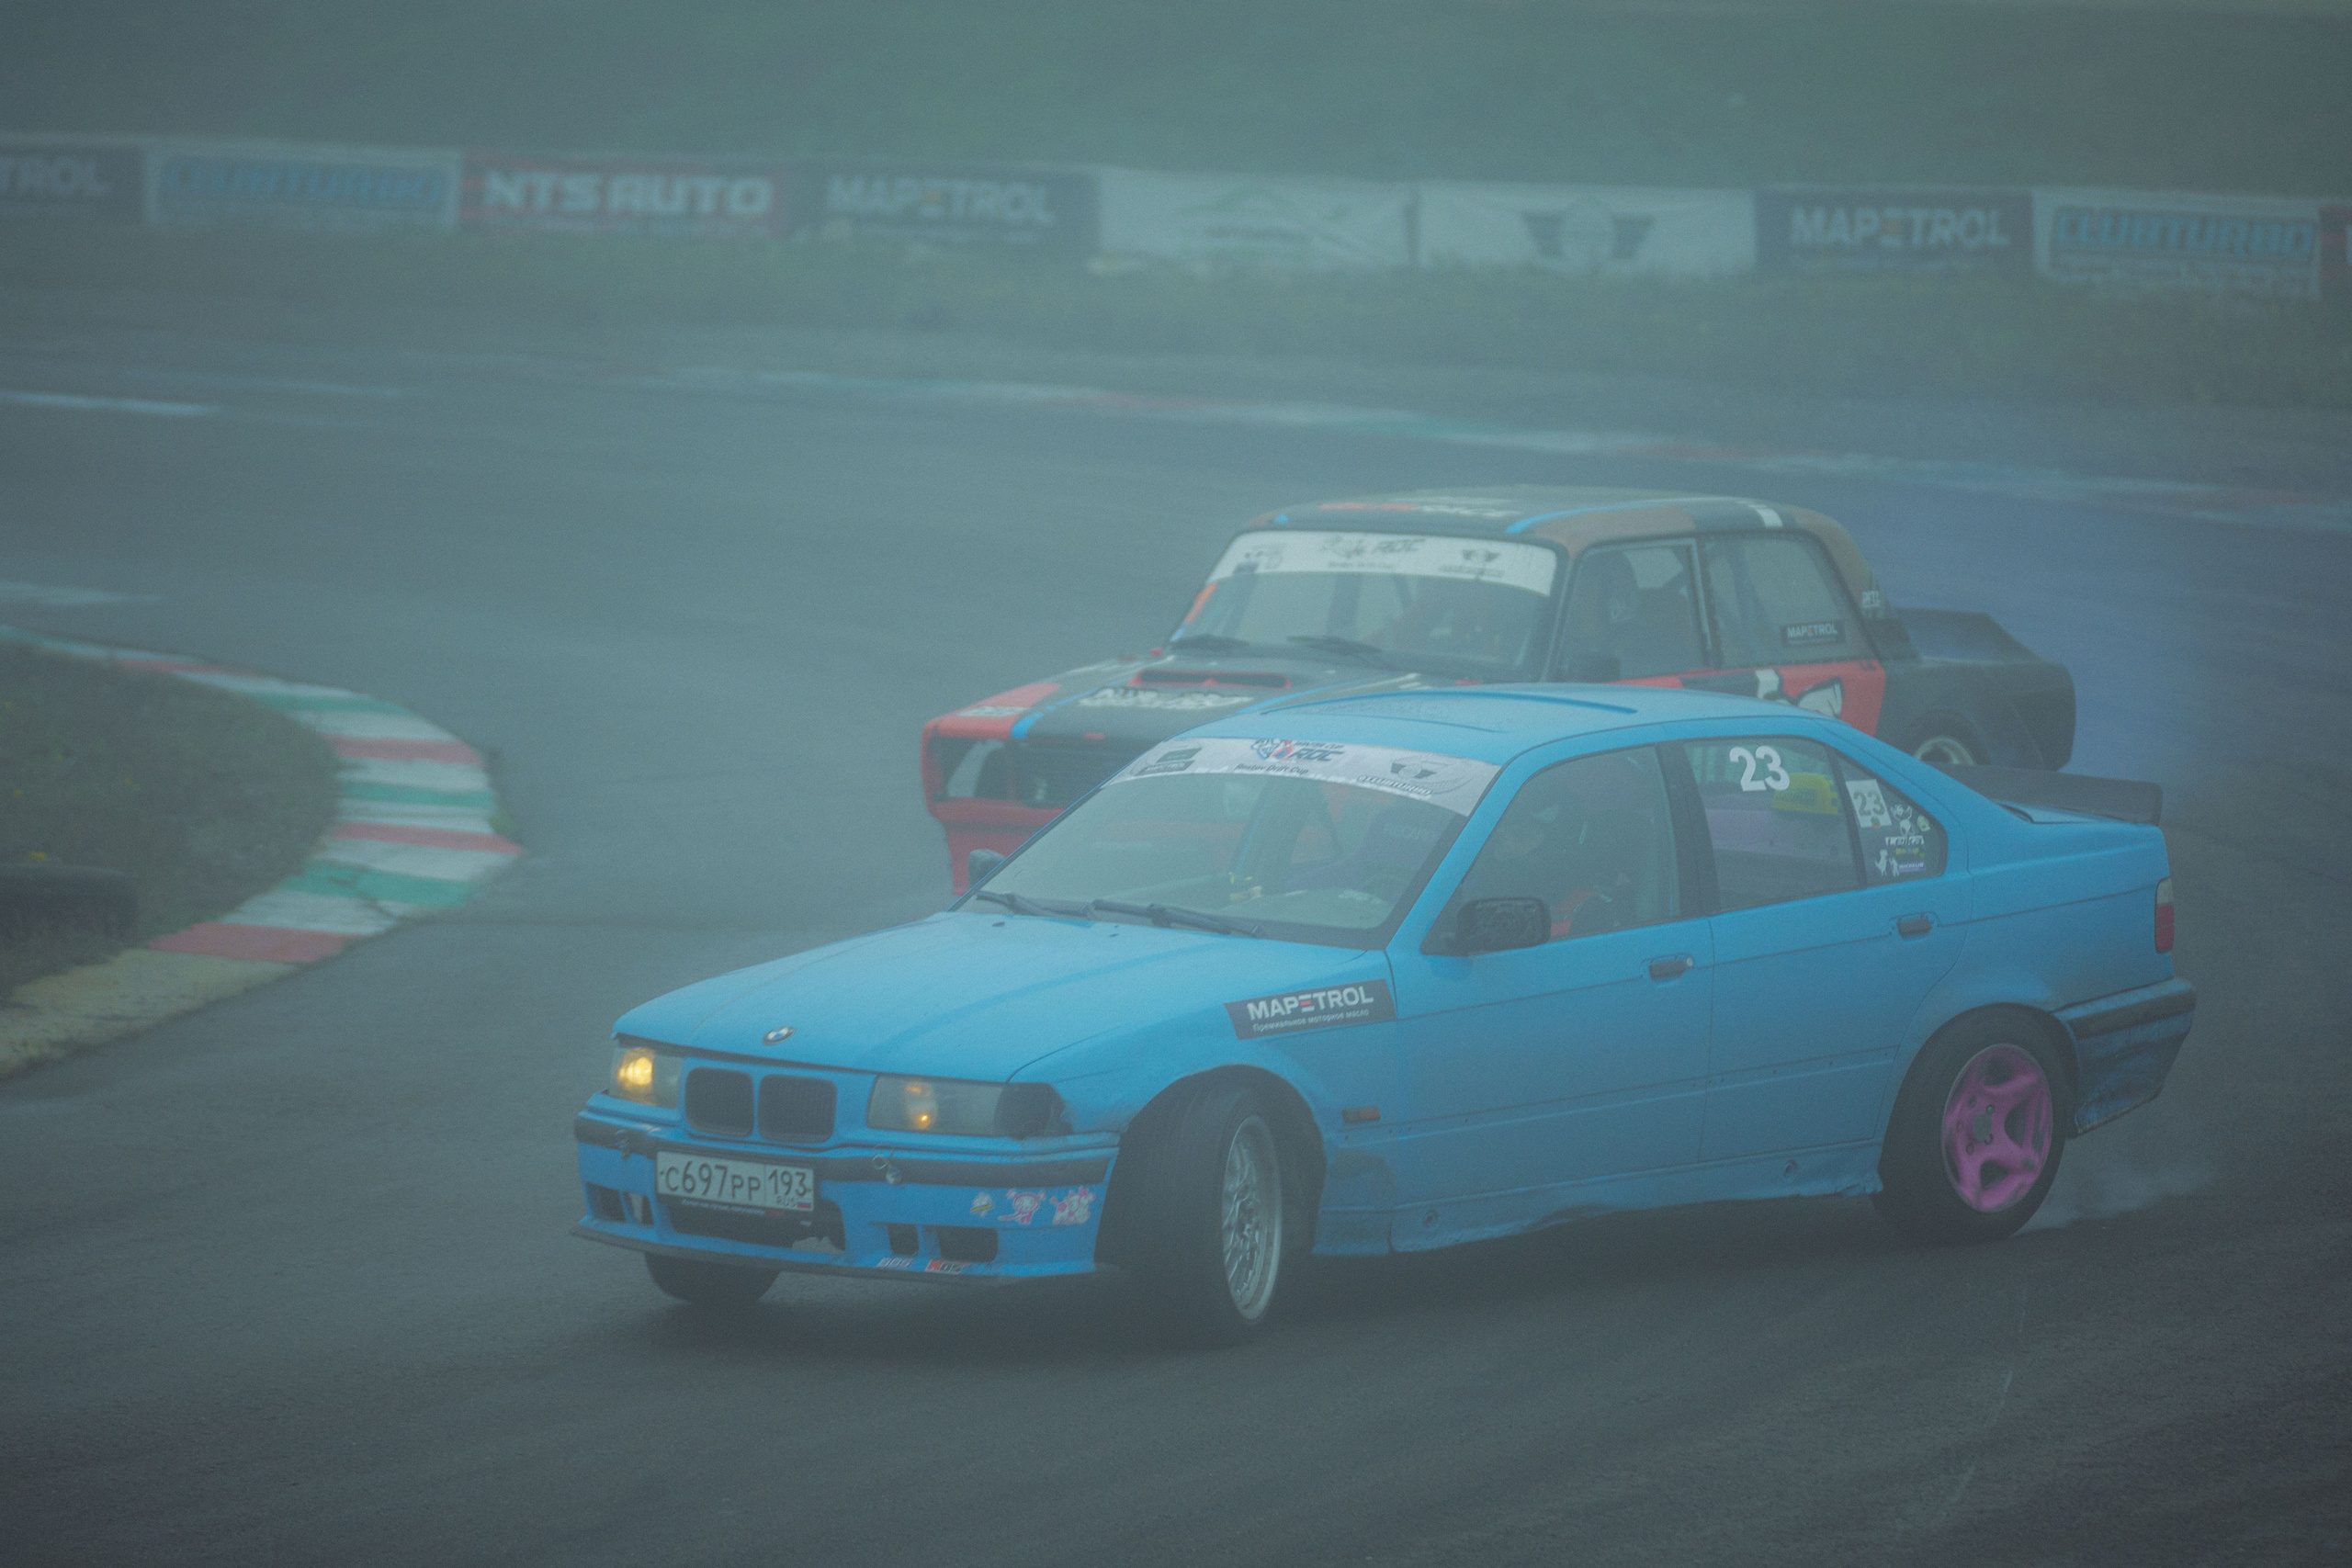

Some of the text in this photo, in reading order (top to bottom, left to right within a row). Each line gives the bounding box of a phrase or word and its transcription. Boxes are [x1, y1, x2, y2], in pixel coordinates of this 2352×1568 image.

[483, 170, 772, 216] NTS AUTO
[825, 175, 1056, 225] MAPETROL
[1790, 206, 2009, 249] MAPETROL
[1787, 623, 1838, 638] MAPETROL
[1729, 745, 1791, 792] 23
[1853, 791, 1886, 817] 23
[1247, 986, 1374, 1021] MAPETROL
[768, 1168, 808, 1198] 193
[776, 1196, 797, 1208] RUS
